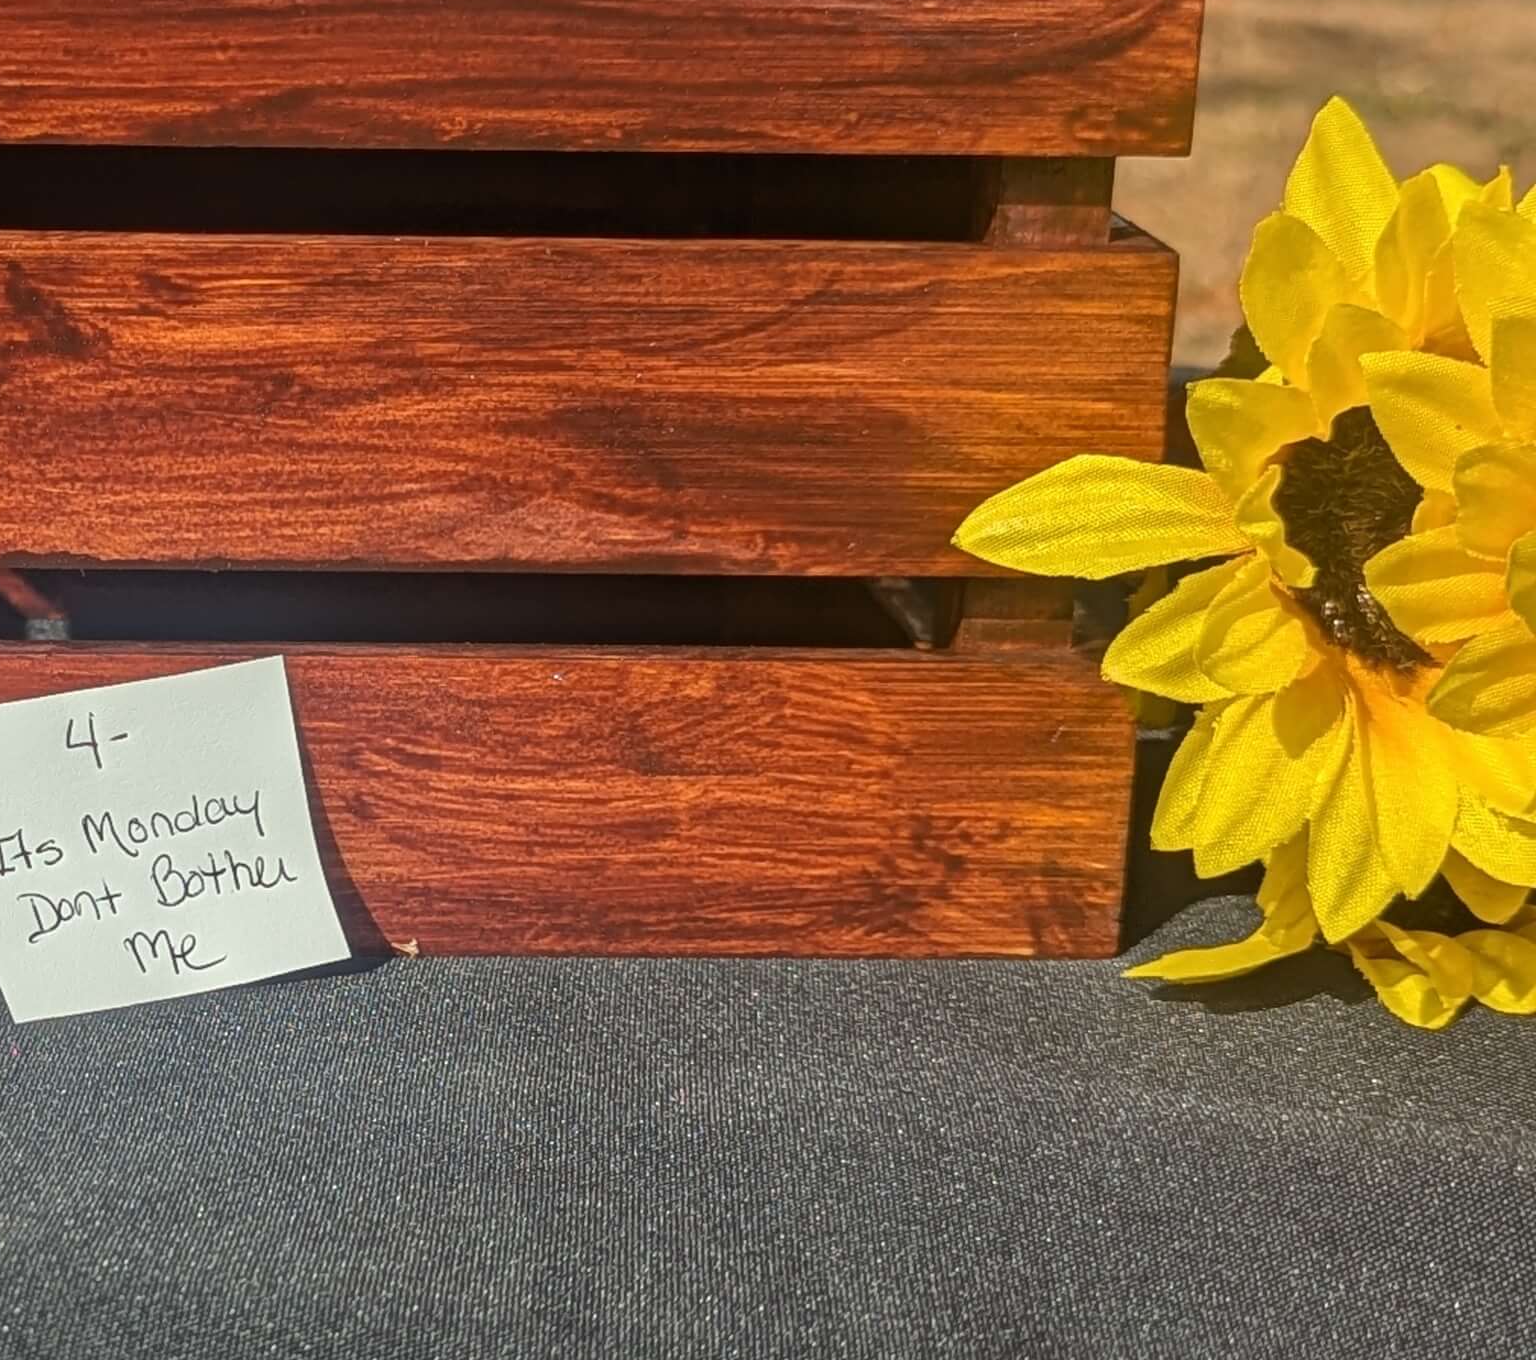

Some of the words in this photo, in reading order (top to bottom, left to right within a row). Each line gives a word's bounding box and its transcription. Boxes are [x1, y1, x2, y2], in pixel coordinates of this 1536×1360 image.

[81, 790, 265, 857] Monday
[17, 880, 122, 943] Dont
[151, 850, 297, 907] Bother
[124, 929, 227, 974] Me
